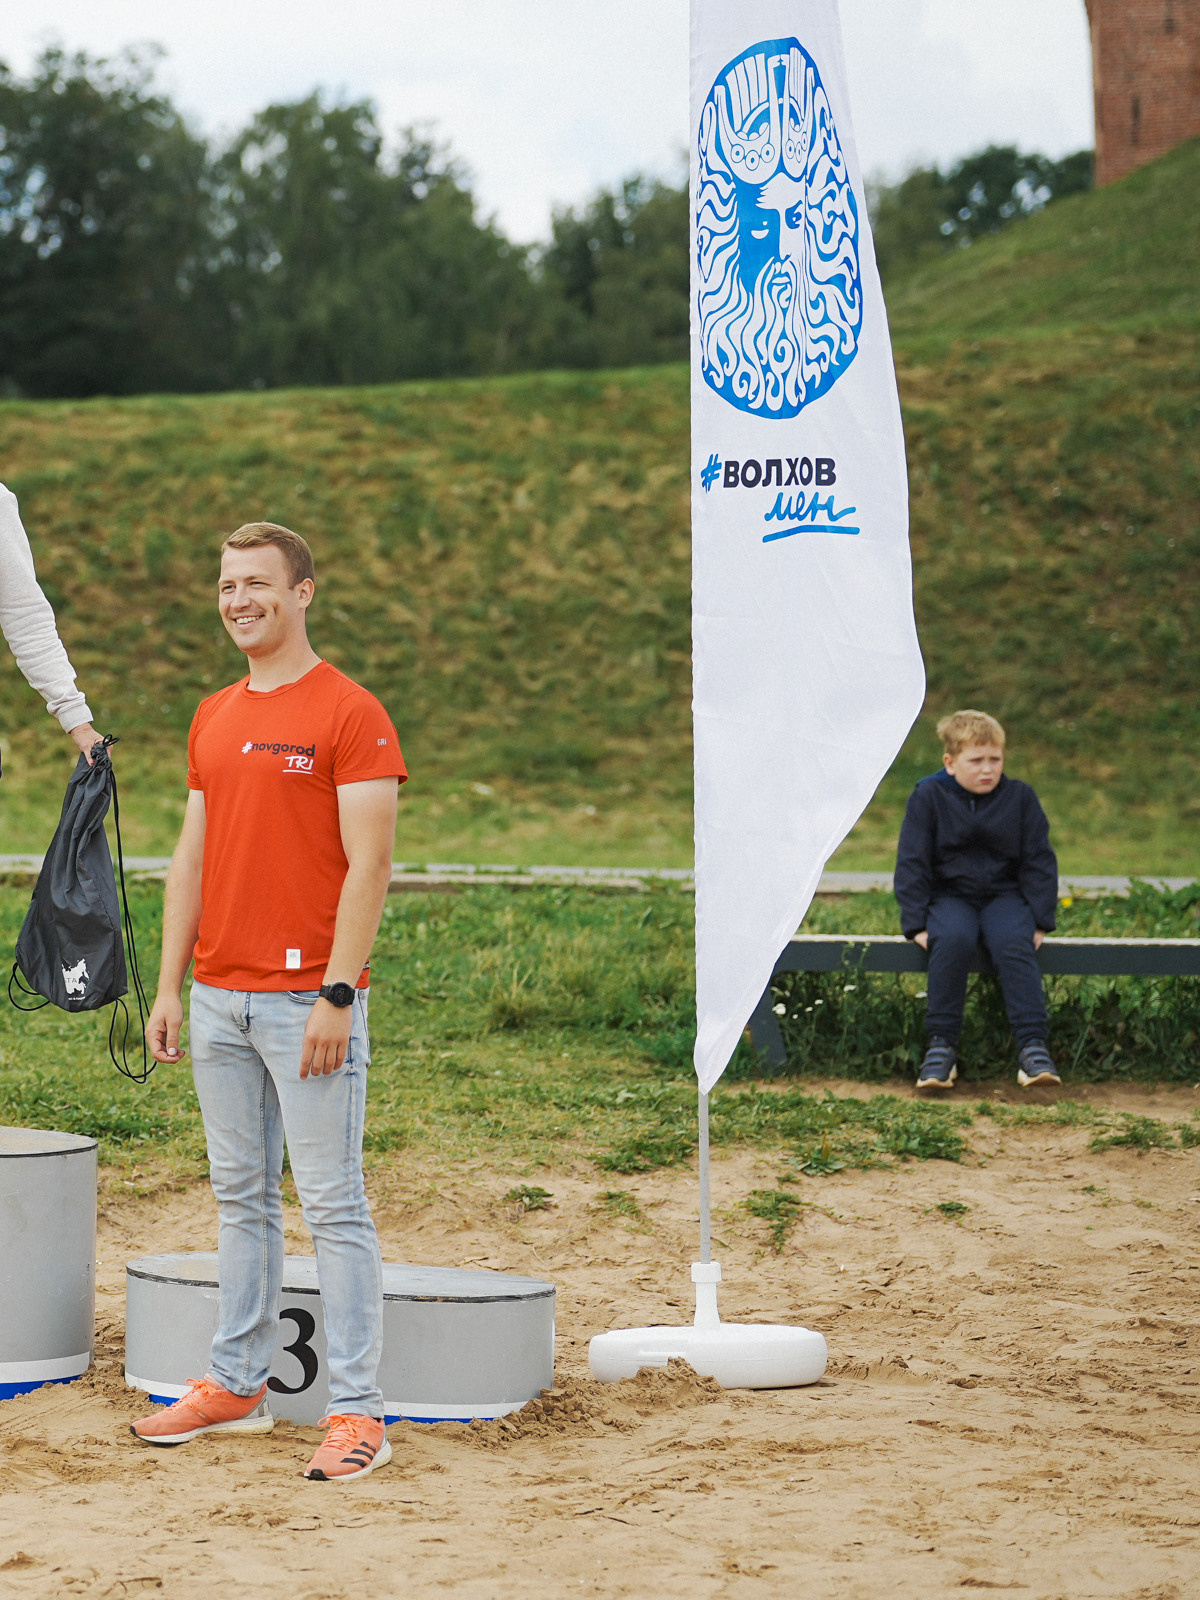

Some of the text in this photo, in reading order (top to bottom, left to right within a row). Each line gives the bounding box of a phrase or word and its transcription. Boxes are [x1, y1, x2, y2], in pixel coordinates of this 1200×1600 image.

[700, 454, 837, 493] #ВОЛХОВ
[241, 741, 316, 757] #novgorod
[284, 755, 314, 770] TRI
[266, 1307, 318, 1394] 3
